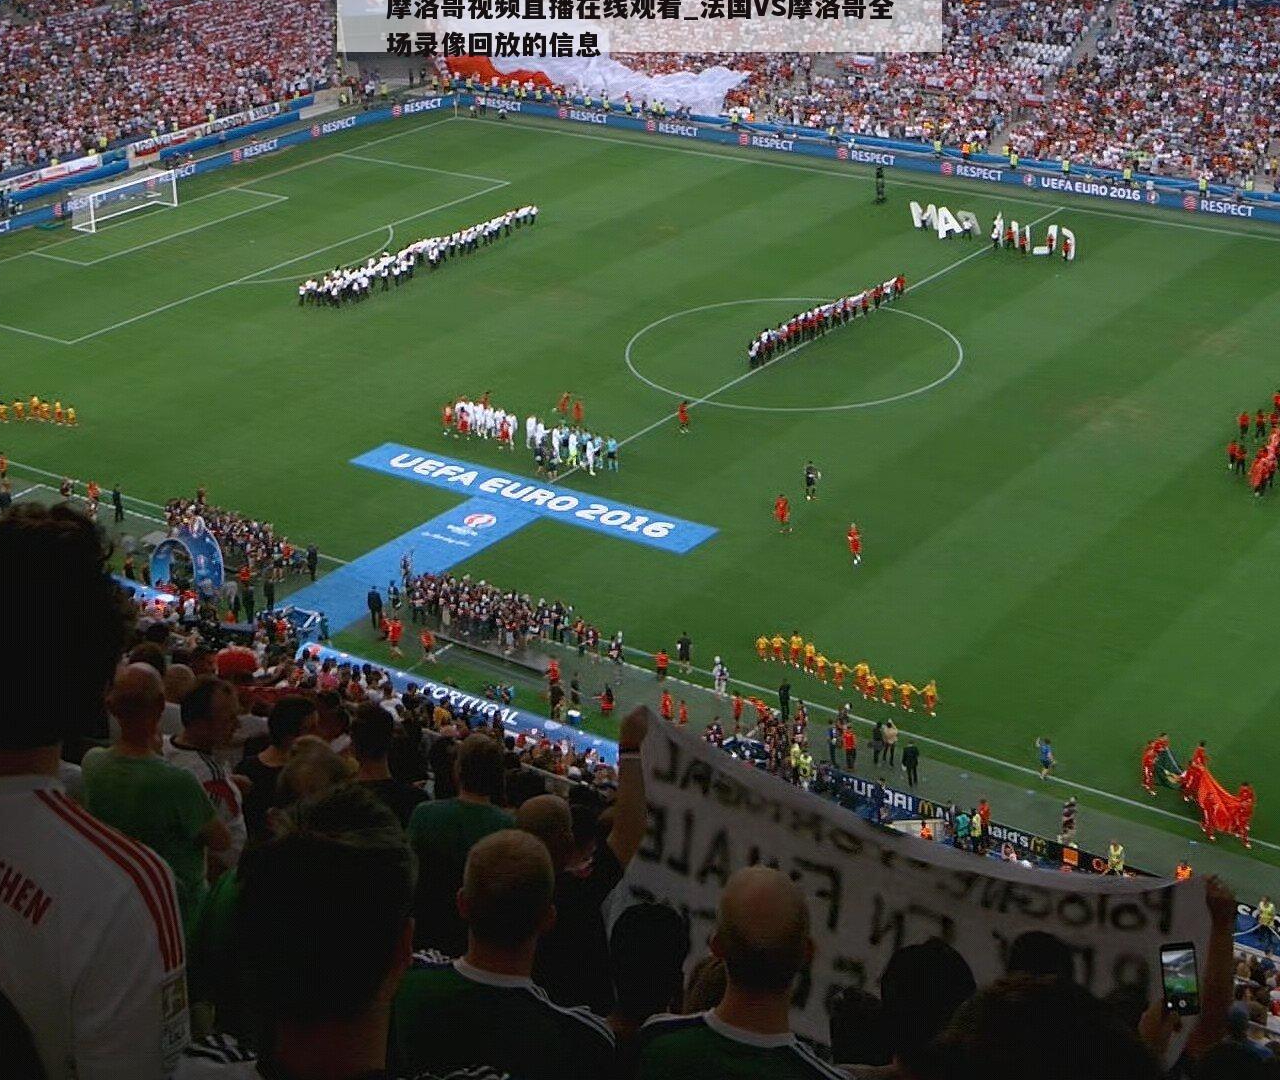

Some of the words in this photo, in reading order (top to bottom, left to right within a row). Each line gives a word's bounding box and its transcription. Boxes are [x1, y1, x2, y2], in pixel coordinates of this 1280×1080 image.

[404, 98, 441, 114] RESPECT
[322, 116, 356, 134] RESPECT
[570, 108, 607, 124] RESPECT
[659, 121, 698, 137] RESPECT
[243, 139, 278, 158] RESPECT
[752, 135, 794, 152] RESPECT
[851, 148, 895, 166] RESPECT
[956, 163, 1003, 182] RESPECT
[1041, 176, 1072, 192] UEFA
[1075, 178, 1107, 197] EURO
[1110, 185, 1141, 201] 2016
[1201, 199, 1255, 217] RESPECT
[389, 452, 478, 486] UEFA
[479, 477, 579, 512] EURO
[575, 503, 676, 538] 2016
